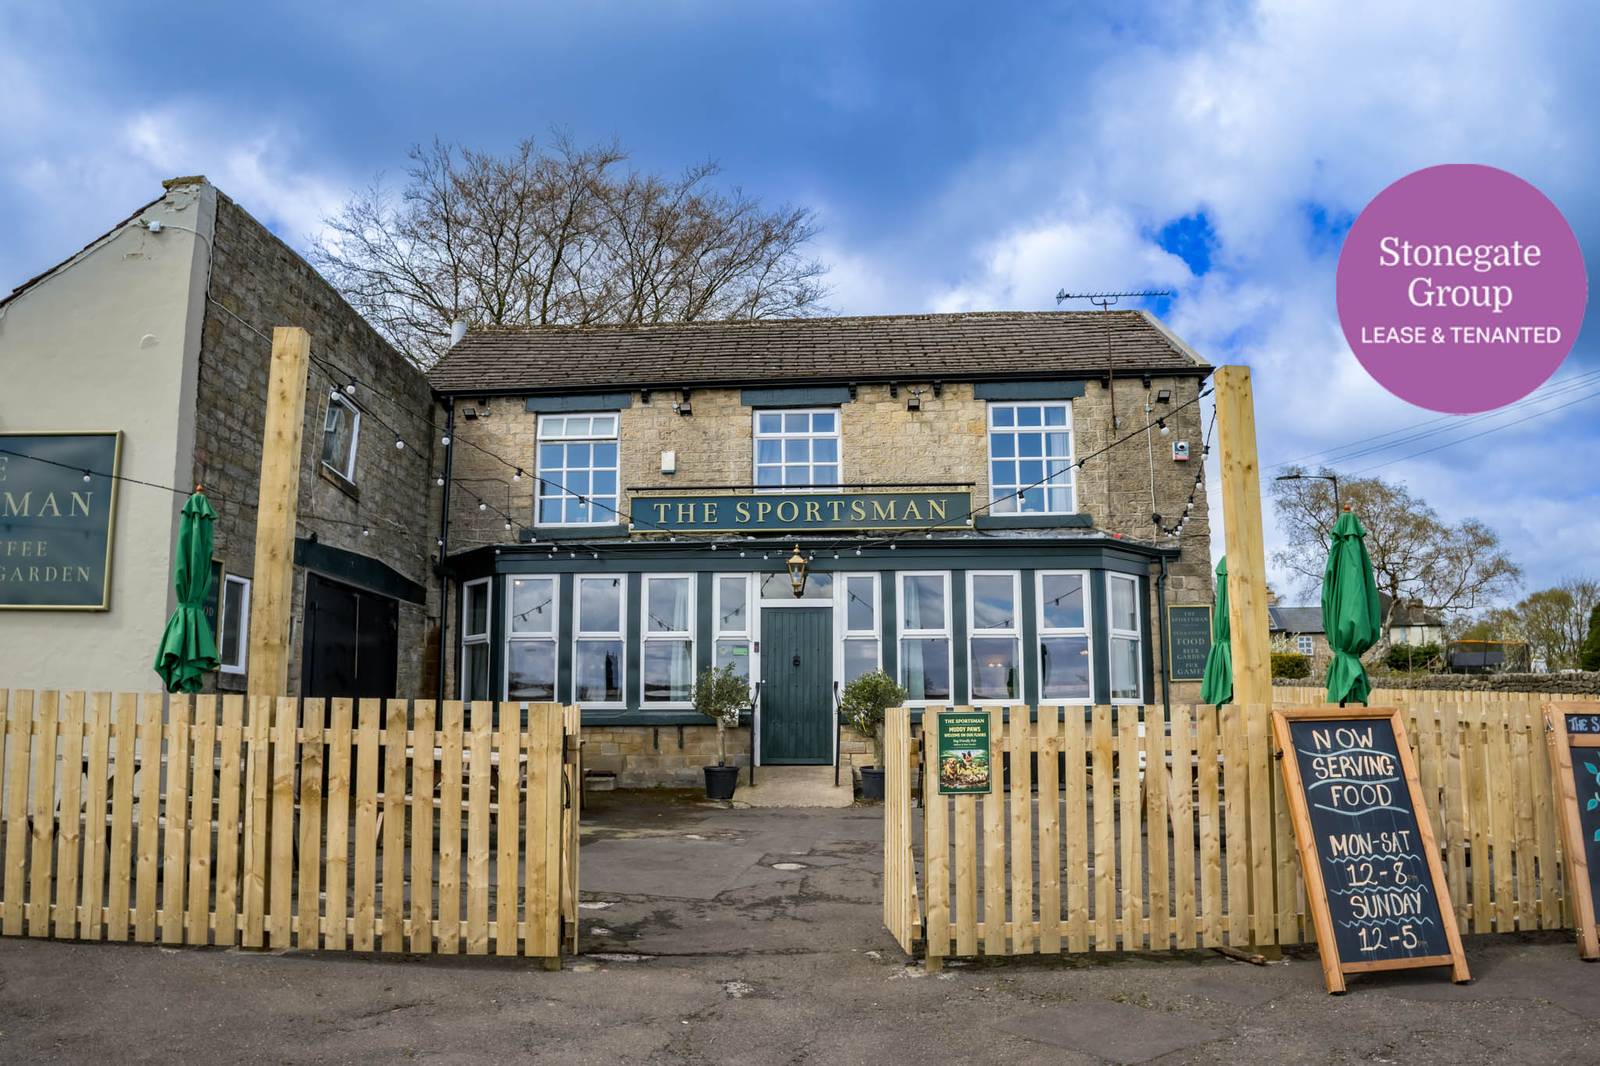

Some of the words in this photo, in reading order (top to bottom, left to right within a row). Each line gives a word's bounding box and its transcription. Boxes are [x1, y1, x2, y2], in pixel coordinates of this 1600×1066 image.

[2, 490, 94, 517] MAN
[653, 501, 719, 524] THE
[735, 498, 949, 523] SPORTSMAN
[0, 540, 48, 558] FEE
[1176, 638, 1205, 646] FOOD
[1568, 716, 1588, 732] THE
[1311, 727, 1374, 750] NOW
[1312, 755, 1395, 780] SERVING
[1330, 784, 1392, 807] FOOD
[1329, 830, 1410, 857] MON-SAT
[1350, 892, 1422, 920] SUNDAY
